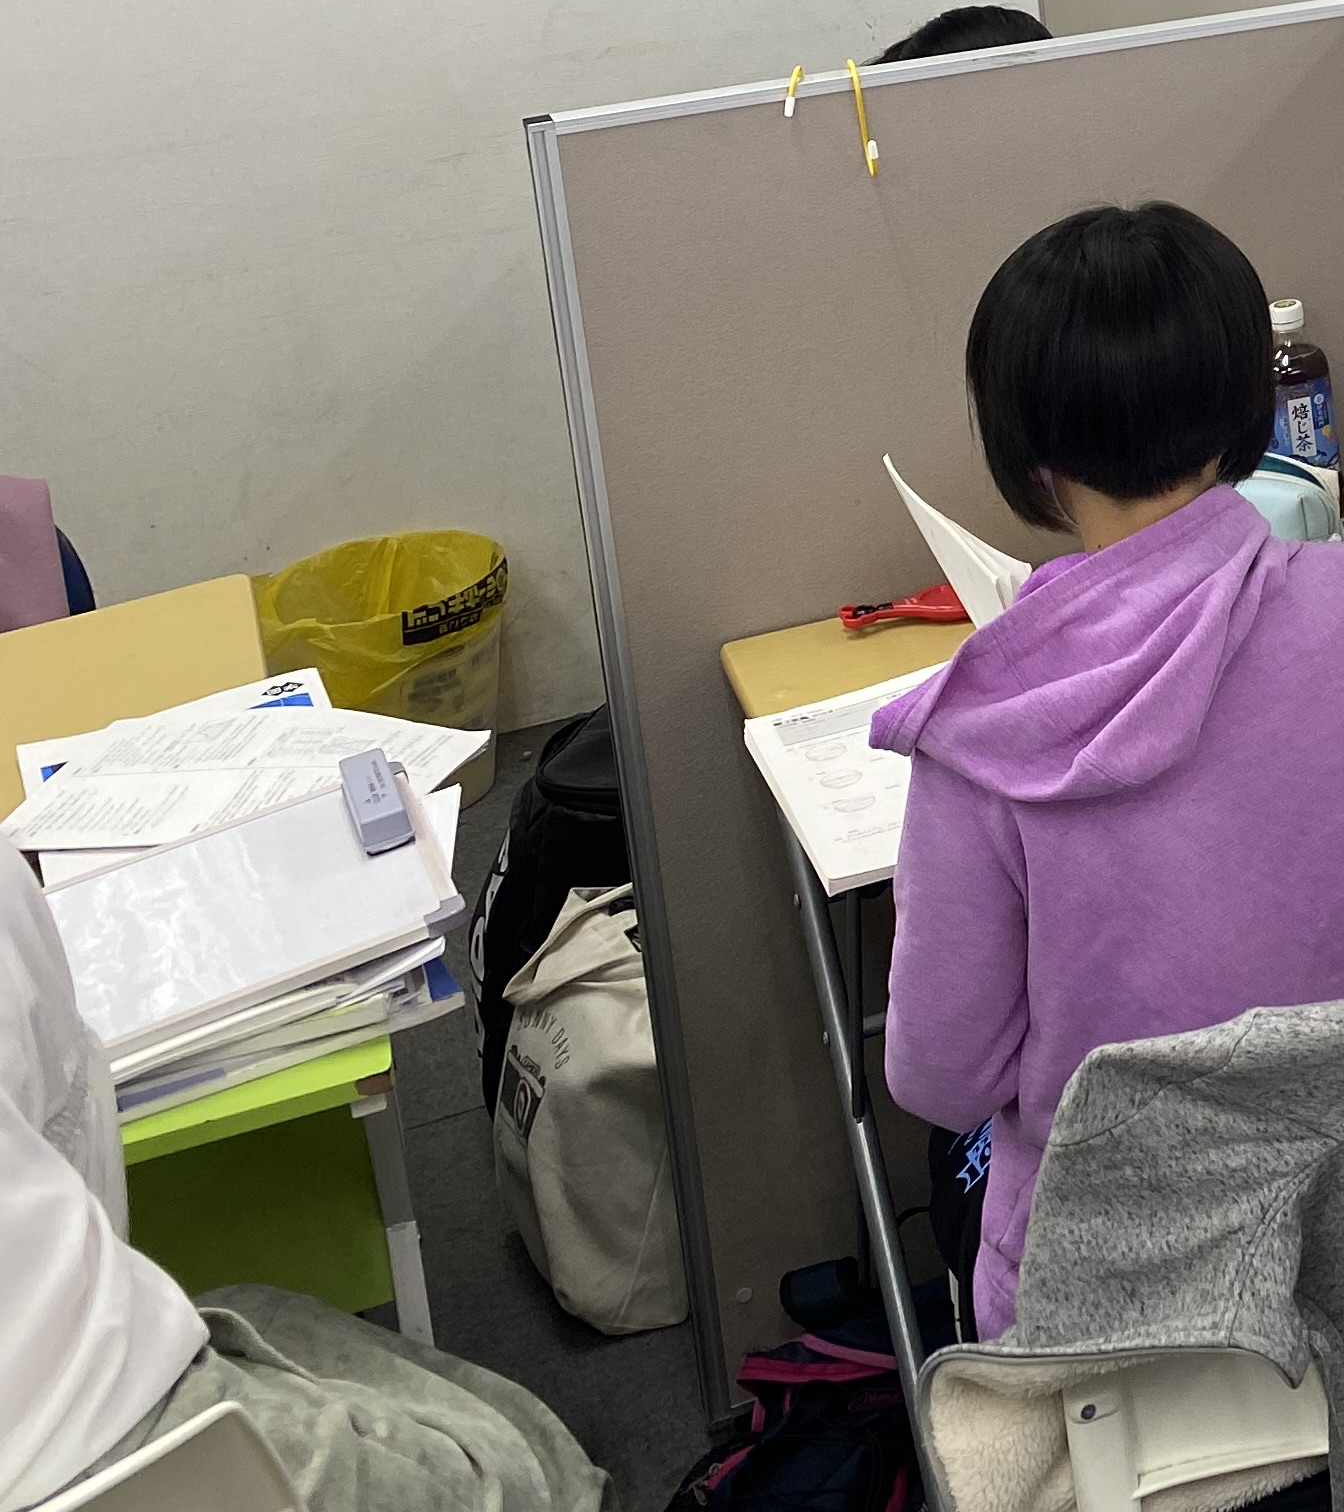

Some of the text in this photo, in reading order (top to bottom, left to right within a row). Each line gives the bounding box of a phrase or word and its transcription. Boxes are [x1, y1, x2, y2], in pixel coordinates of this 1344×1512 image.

[1291, 403, 1313, 452] 焙じ茶
[551, 1027, 570, 1070] DAYS
